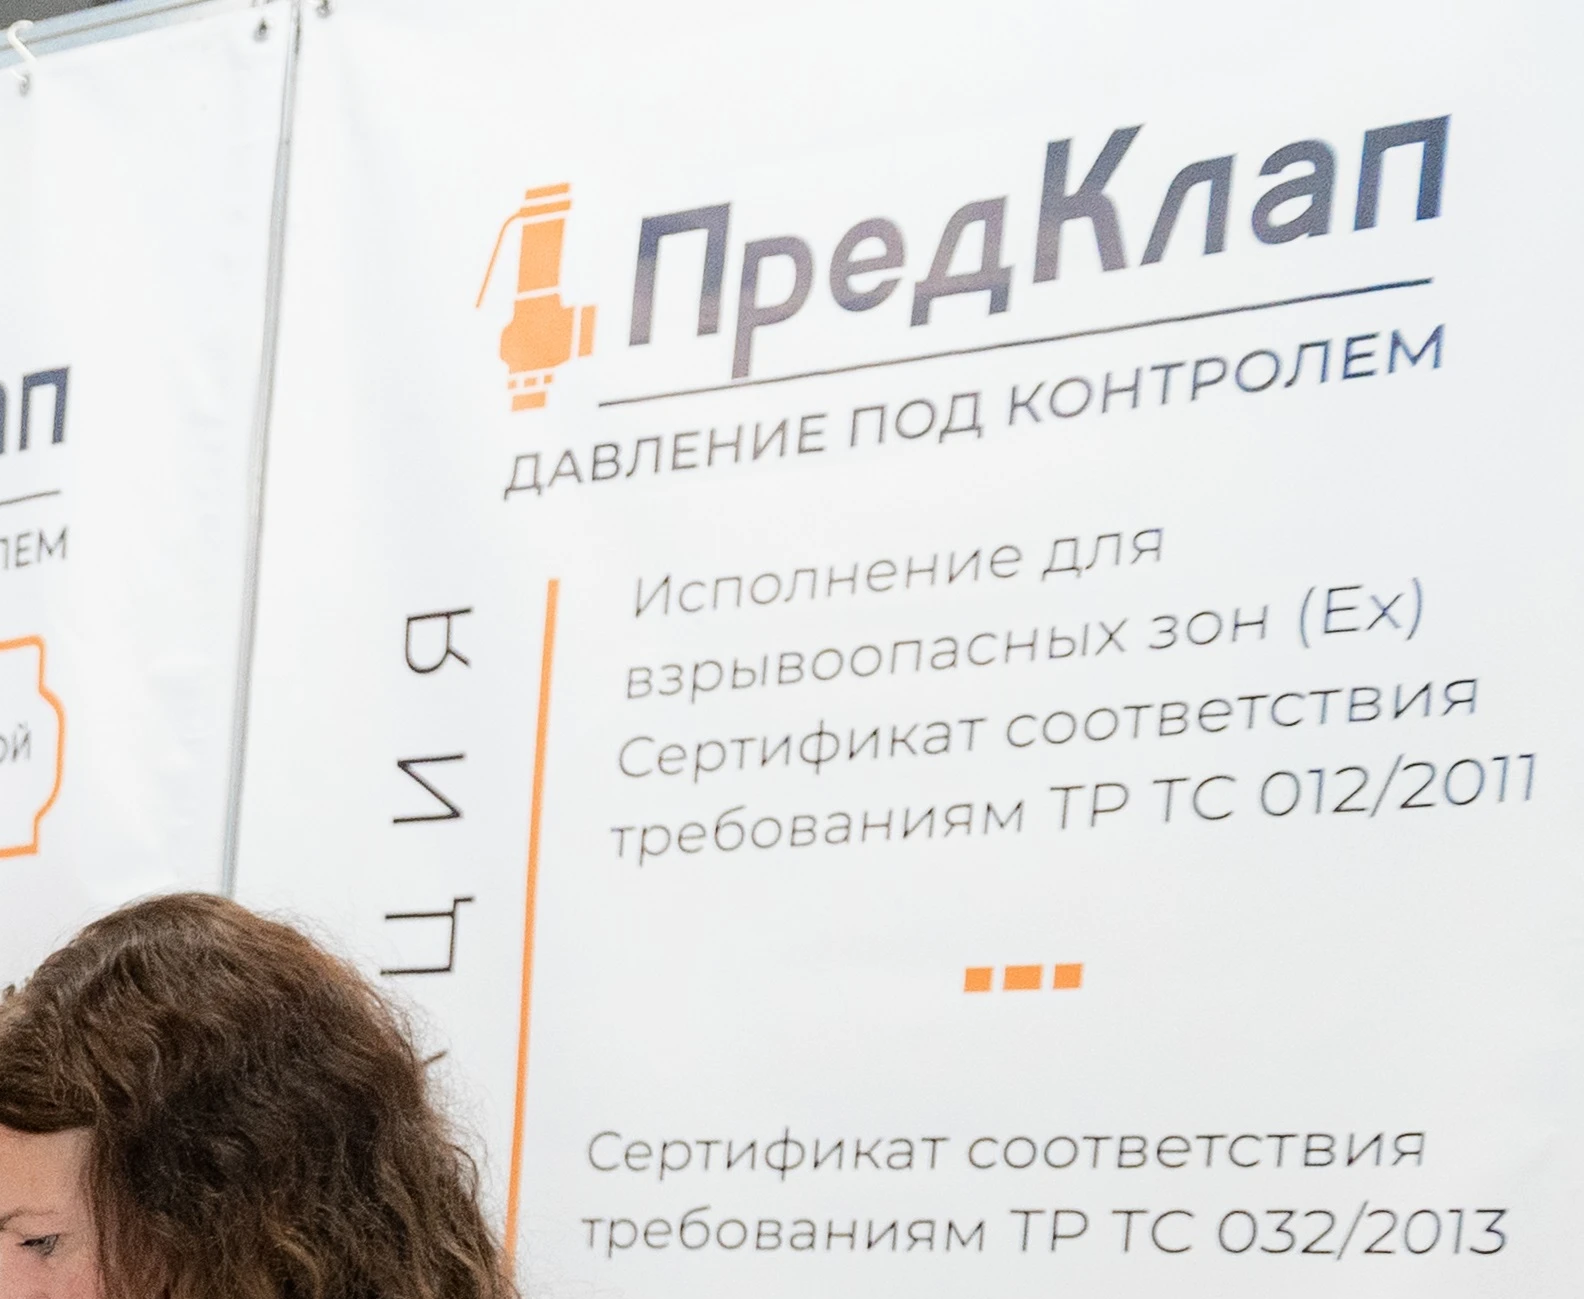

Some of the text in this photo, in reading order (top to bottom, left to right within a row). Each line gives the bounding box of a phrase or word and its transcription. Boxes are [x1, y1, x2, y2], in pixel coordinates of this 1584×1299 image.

[628, 114, 1451, 383] ПредКлап
[502, 323, 1445, 502] ДАВЛЕНИЕ ПОД КОНТРОЛЕМ
[634, 527, 1163, 619] Исполнение для
[626, 617, 1128, 705] взрывоопасных
[1148, 605, 1268, 651] зон
[618, 677, 1478, 784] Сертификат соответствия
[610, 753, 1535, 867] требованиям ТР ТС 012/2011
[587, 1127, 1425, 1182] Сертификат соответствия
[581, 1201, 1508, 1261] требованиям ТР ТС 032/2013
